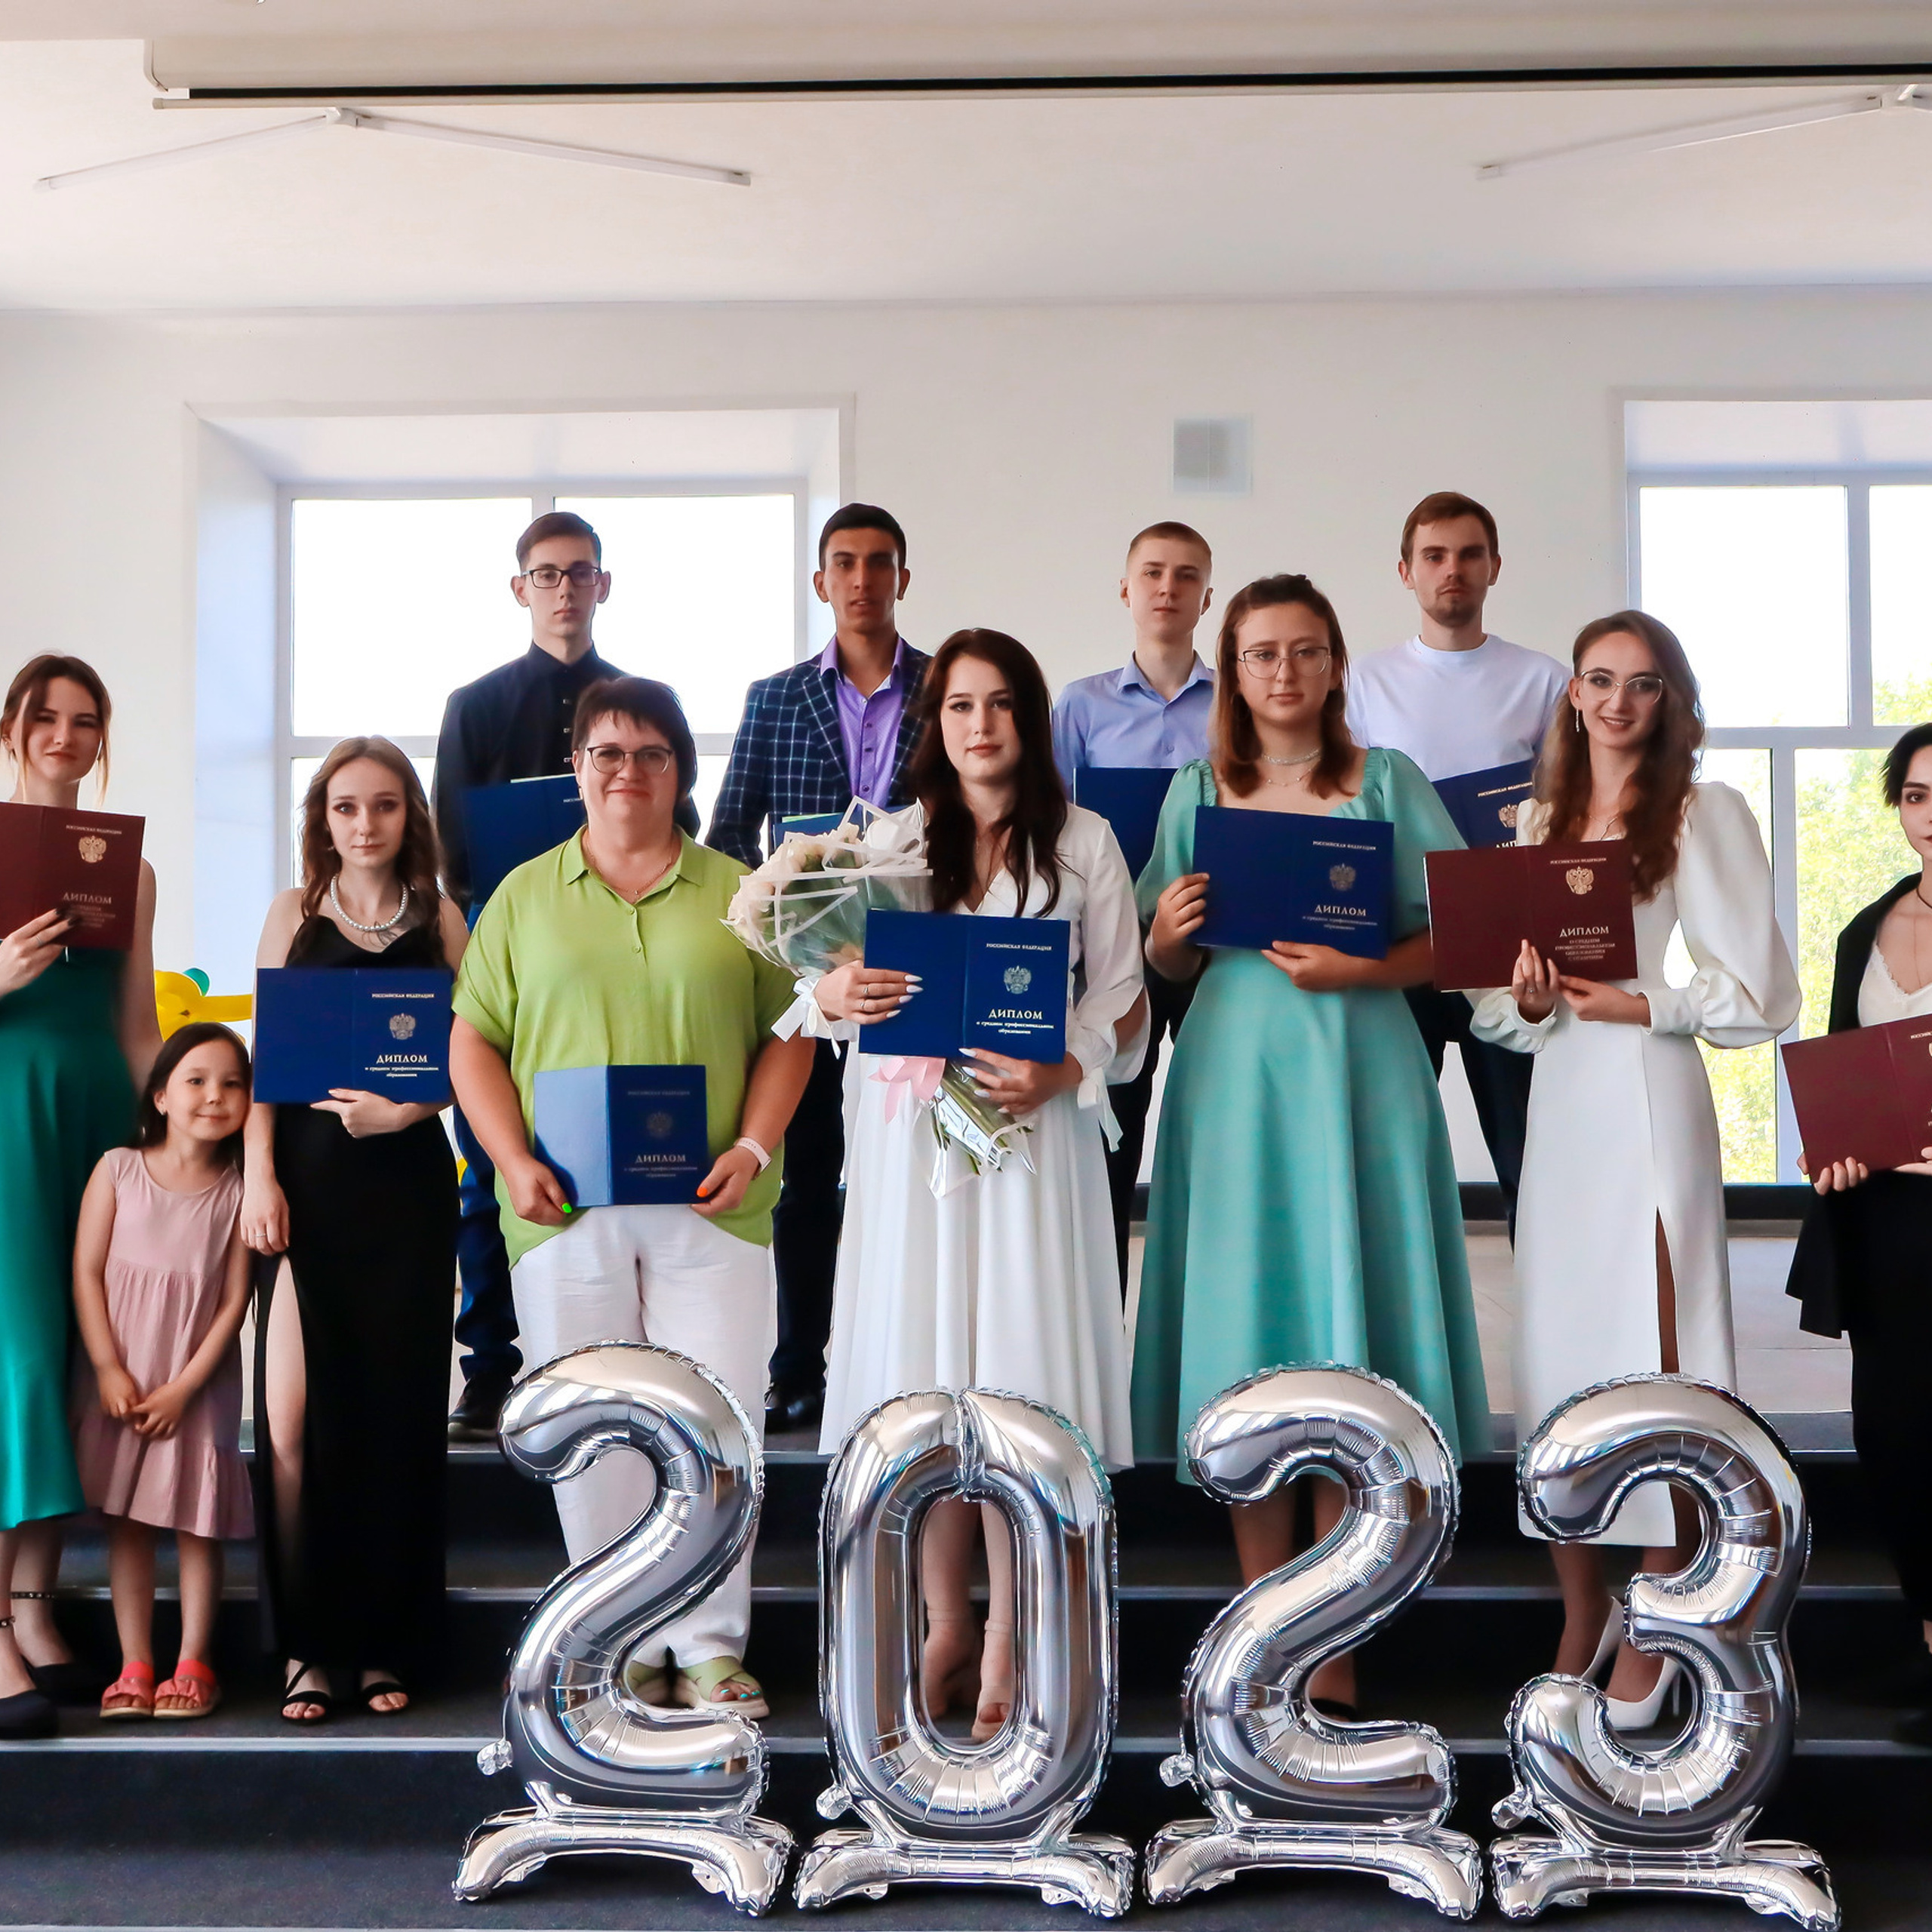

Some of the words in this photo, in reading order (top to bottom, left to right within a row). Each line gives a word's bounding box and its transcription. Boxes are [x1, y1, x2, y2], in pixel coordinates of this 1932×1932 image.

[63, 892, 112, 904] ДИПЛОМ
[1314, 904, 1367, 916] ДИПЛОМ
[1559, 926, 1609, 937] ДИПЛОМ
[988, 1008, 1043, 1020] ДИПЛОМ
[376, 1054, 428, 1064] ДИПЛОМ
[635, 1154, 686, 1164] ДИПЛОМ
[497, 1340, 1813, 1841] 2023
